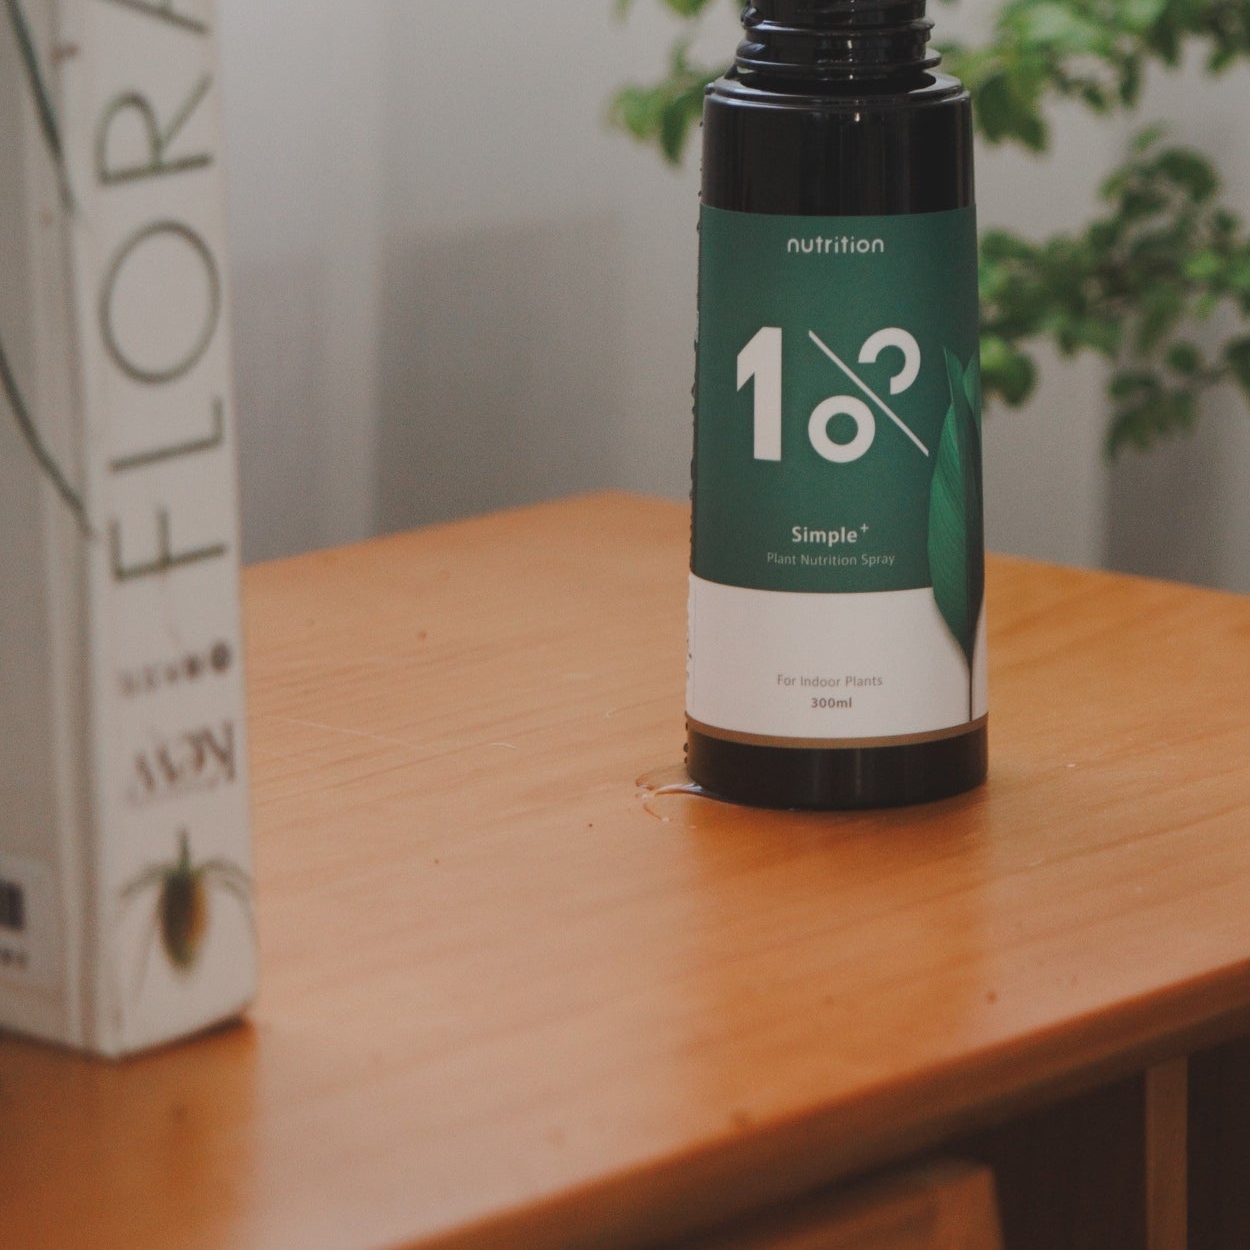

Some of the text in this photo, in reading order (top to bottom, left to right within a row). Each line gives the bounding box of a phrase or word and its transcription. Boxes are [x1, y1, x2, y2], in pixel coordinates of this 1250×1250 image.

[787, 235, 885, 254] nutrition
[766, 552, 896, 567] Plant Nutrition Spray
[777, 674, 884, 688] For Indoor Plants
[811, 697, 853, 709] 300ml
